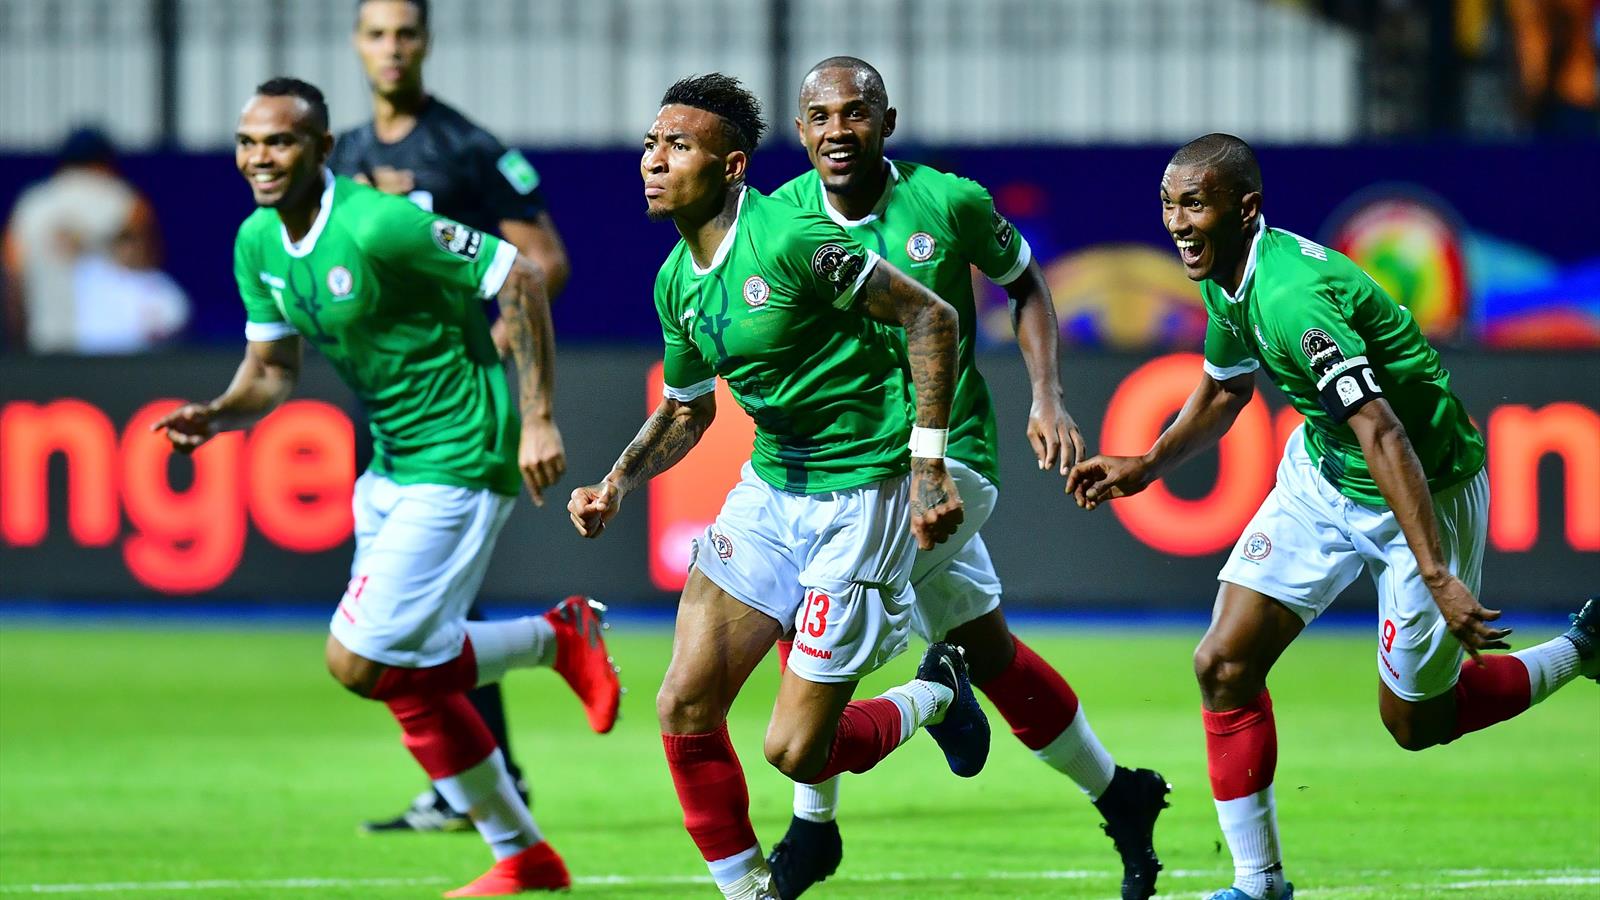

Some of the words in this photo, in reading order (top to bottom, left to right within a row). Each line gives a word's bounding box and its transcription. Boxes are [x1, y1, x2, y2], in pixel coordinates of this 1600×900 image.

[1361, 367, 1383, 393] C
[800, 591, 830, 638] 13
[1381, 618, 1397, 654] 9
